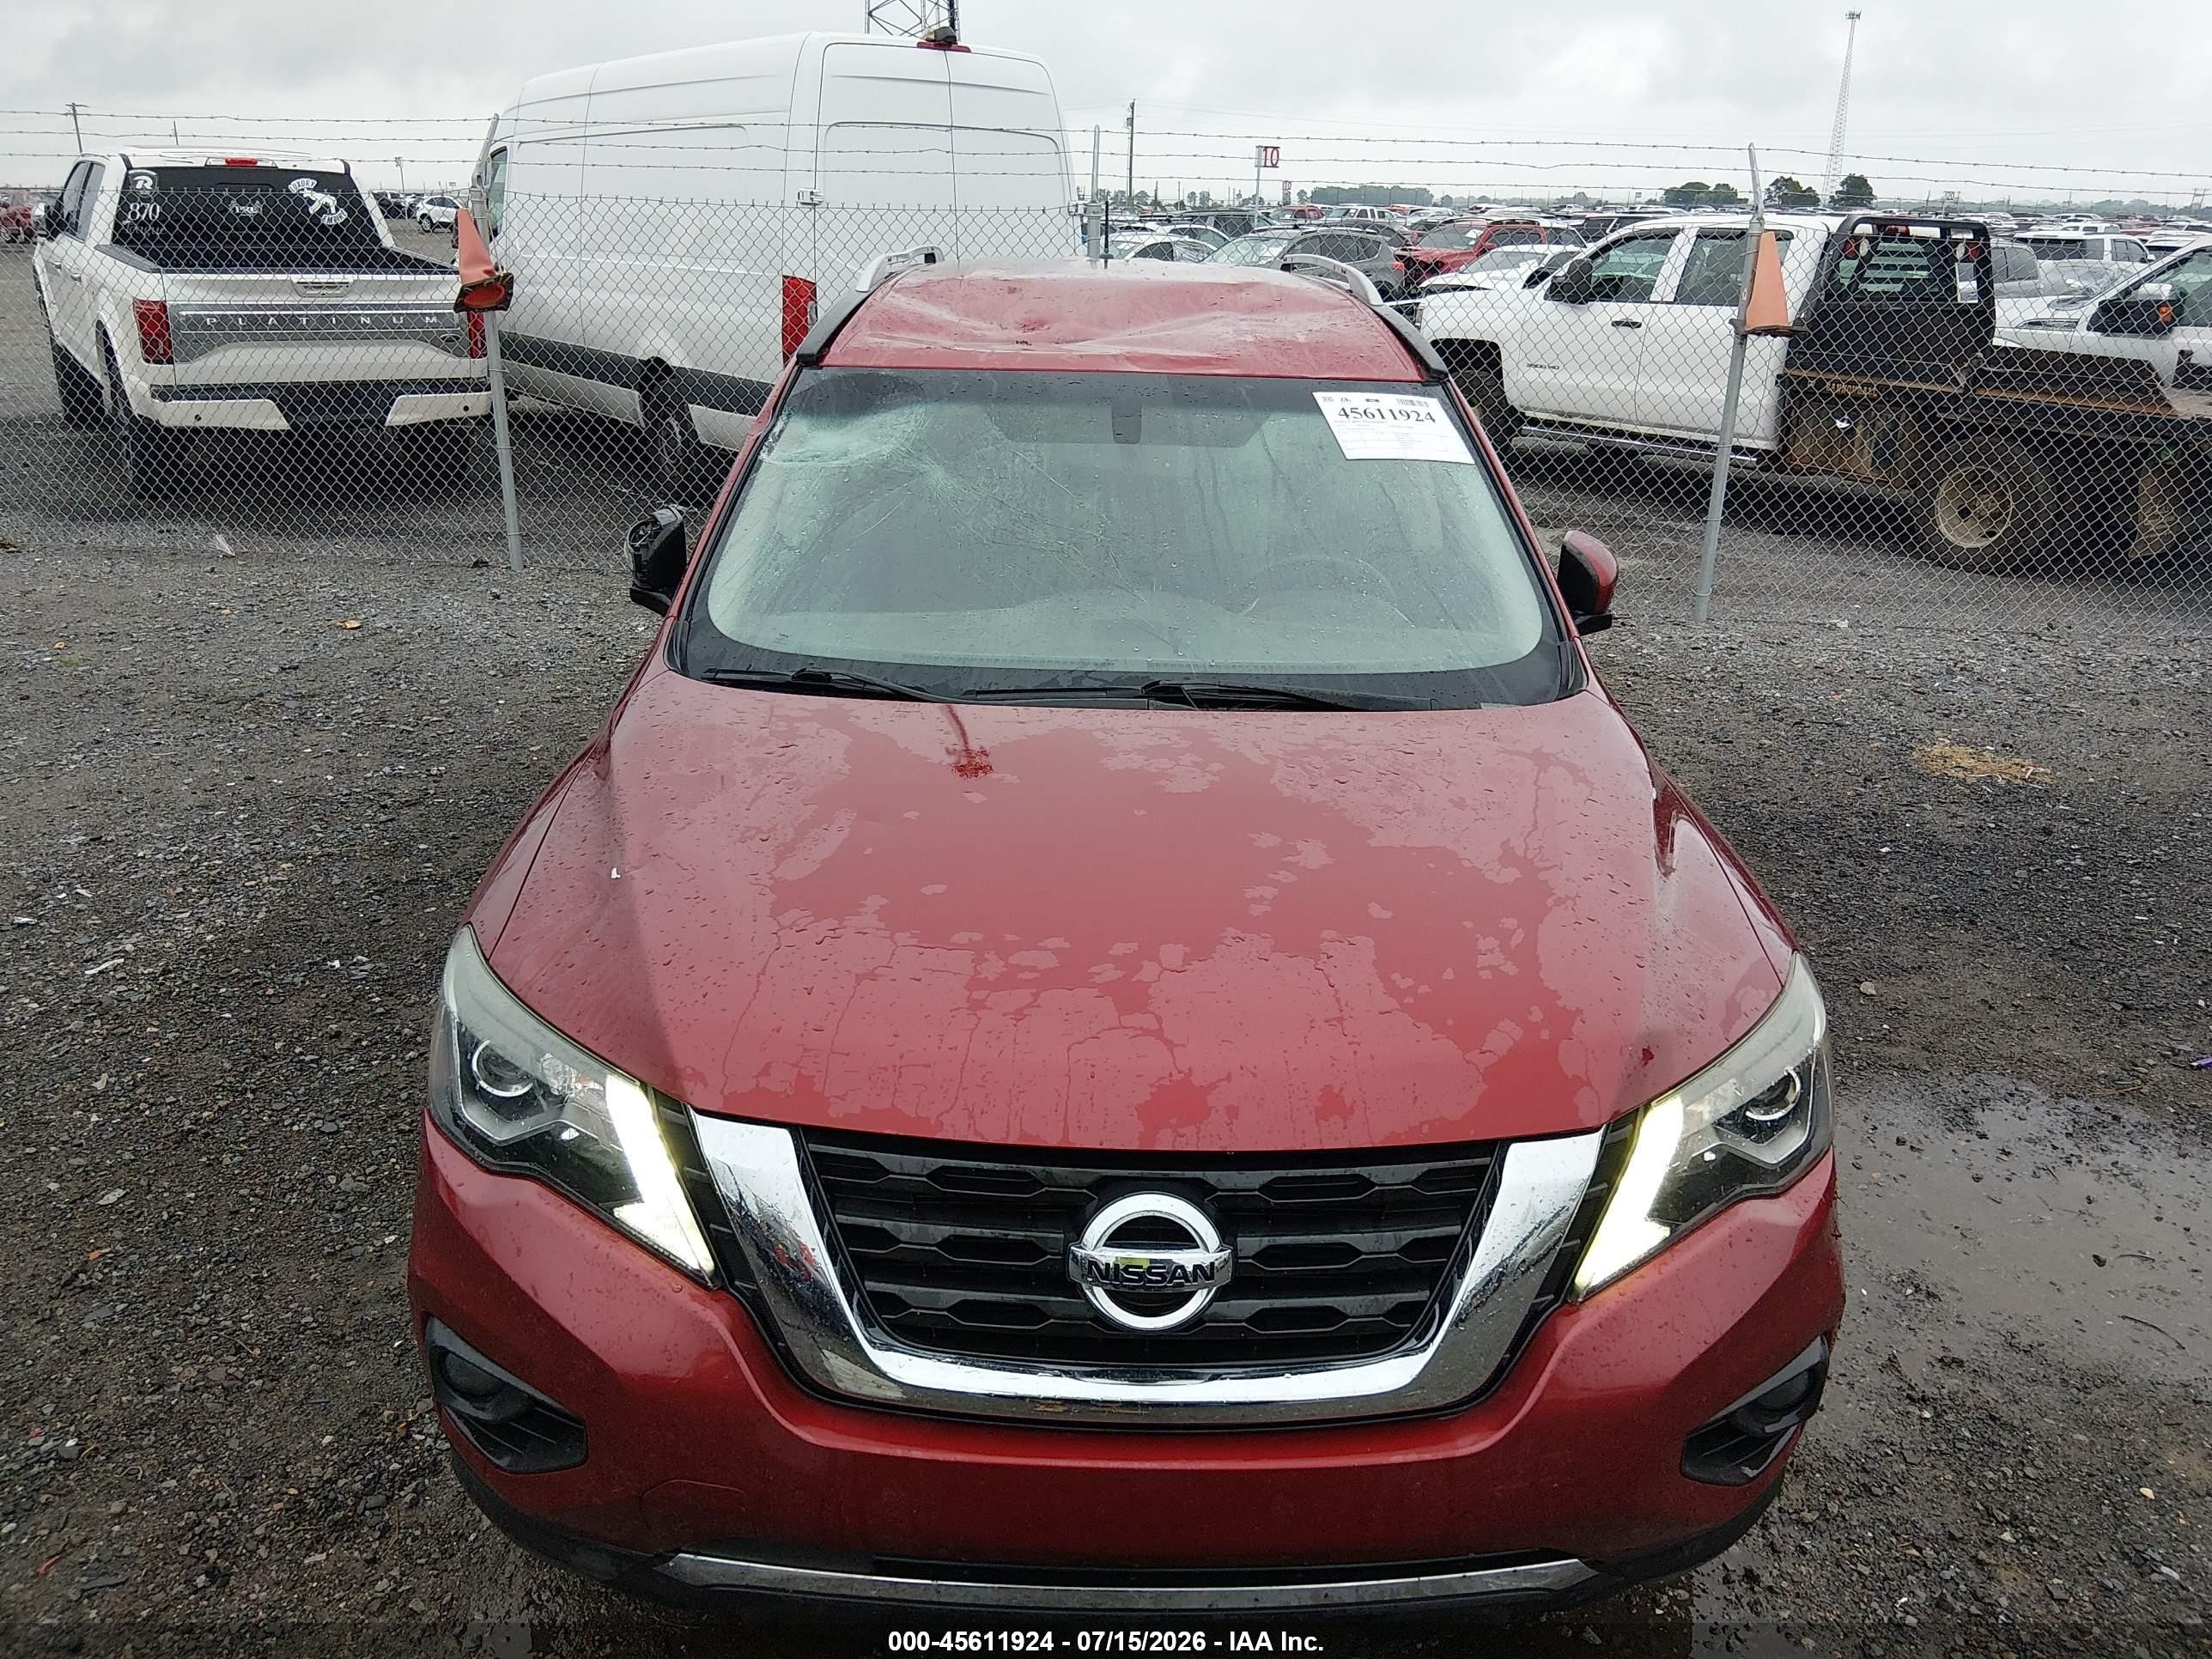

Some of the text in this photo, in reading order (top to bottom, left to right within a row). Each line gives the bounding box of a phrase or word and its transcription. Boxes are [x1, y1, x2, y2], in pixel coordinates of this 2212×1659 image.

[1263, 147, 1279, 167] 10
[289, 179, 317, 193] LUXURY
[128, 202, 161, 221] 870
[322, 209, 348, 225] EMPIRE
[206, 315, 439, 326] PLATINUM
[1338, 407, 1437, 423] 45611924
[1086, 1257, 1216, 1286] NISSAN
